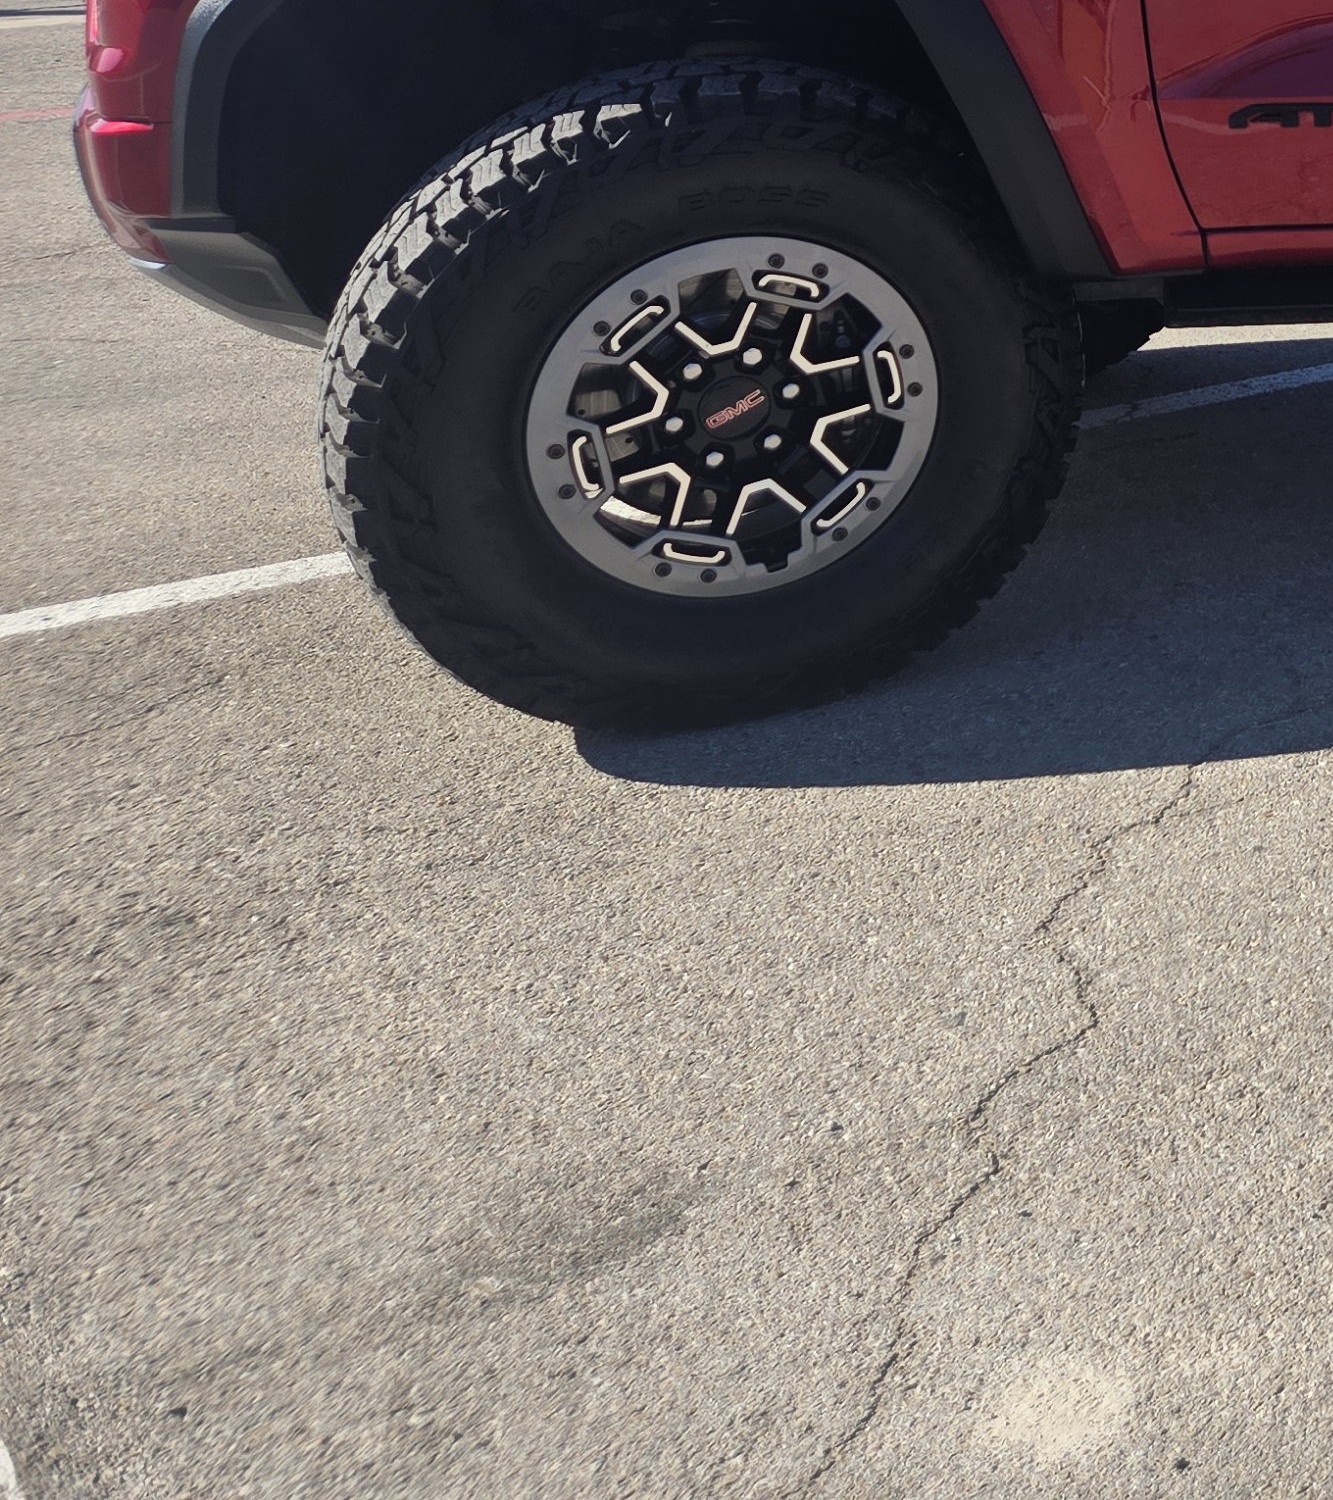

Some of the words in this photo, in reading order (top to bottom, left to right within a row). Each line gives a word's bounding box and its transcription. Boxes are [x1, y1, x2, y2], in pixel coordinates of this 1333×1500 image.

[514, 216, 645, 314] BAJA
[678, 185, 831, 214] BOSS
[706, 389, 765, 428] GMC
